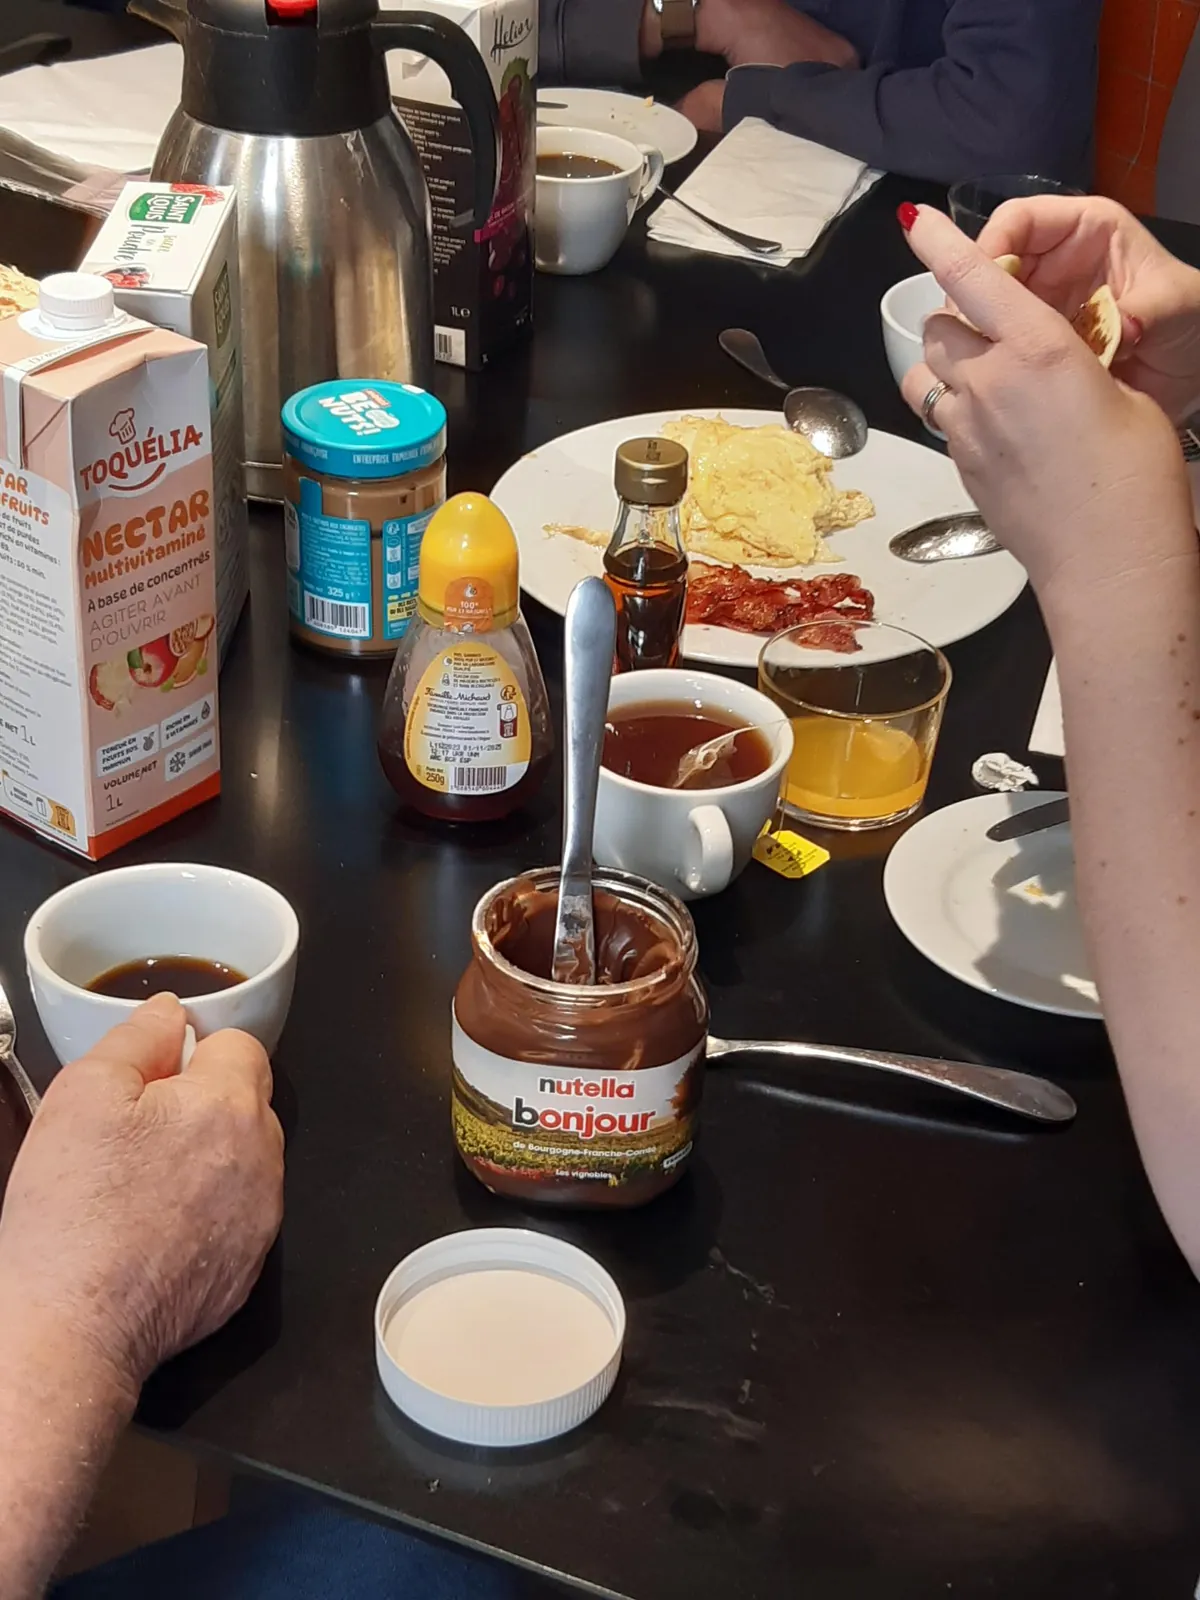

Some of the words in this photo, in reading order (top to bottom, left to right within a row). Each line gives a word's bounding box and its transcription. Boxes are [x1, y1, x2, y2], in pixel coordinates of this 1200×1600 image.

[145, 194, 174, 220] LOUIS
[166, 195, 196, 222] SAINT
[113, 224, 171, 261] Poudre
[318, 397, 381, 436] NUTS!
[339, 391, 381, 413] BE
[80, 424, 203, 491] TOQUÉLIA
[82, 489, 210, 568] NECTAR
[85, 523, 206, 590] Multivitaminé
[98, 588, 127, 609] base
[129, 582, 145, 597] de
[147, 550, 211, 588] concentrés
[327, 586, 344, 598] 325
[90, 599, 147, 635] AGITER
[153, 574, 201, 608] AVANT
[91, 610, 166, 652] D'OUVRIR
[425, 687, 453, 699] Famille
[454, 692, 491, 701] Michaud
[104, 770, 140, 790] VOLUME
[141, 760, 158, 775] NET
[426, 772, 445, 787] 250g
[539, 1077, 635, 1099] nutella
[514, 1097, 656, 1138] bonjour
[513, 1141, 526, 1150] de
[555, 1169, 569, 1177] Les
[571, 1169, 613, 1180] vignobles
